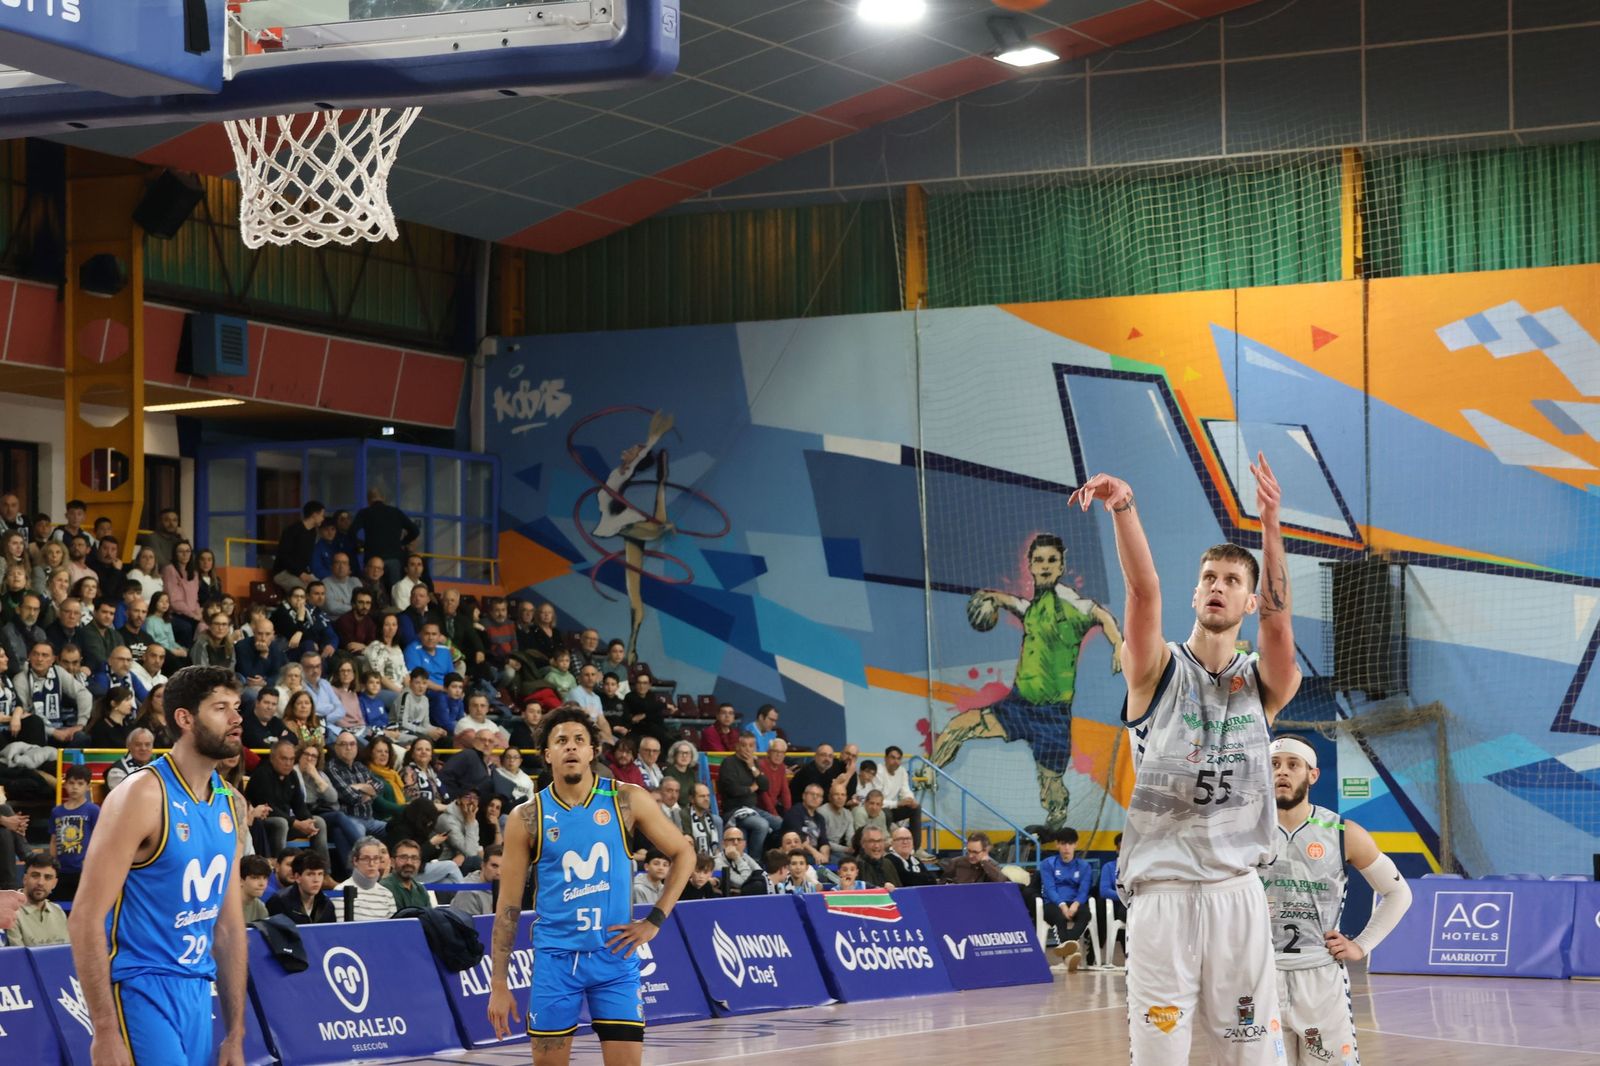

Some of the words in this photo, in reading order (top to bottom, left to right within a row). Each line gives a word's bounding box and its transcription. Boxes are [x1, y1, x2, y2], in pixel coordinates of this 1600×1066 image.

[1193, 769, 1233, 805] 55
[576, 907, 603, 931] 51
[1443, 902, 1500, 929] AC
[847, 926, 925, 943] LÁCTEAS
[1283, 924, 1301, 954] 2
[1442, 932, 1499, 941] HOTELS
[178, 934, 208, 965] 29
[1440, 953, 1497, 962] MARRIOTT
[748, 965, 778, 988] Chef
[318, 1016, 407, 1041] MORALEJO
[1223, 1025, 1267, 1039] ZAMORA
[352, 1041, 389, 1052] SELECCIÓN
